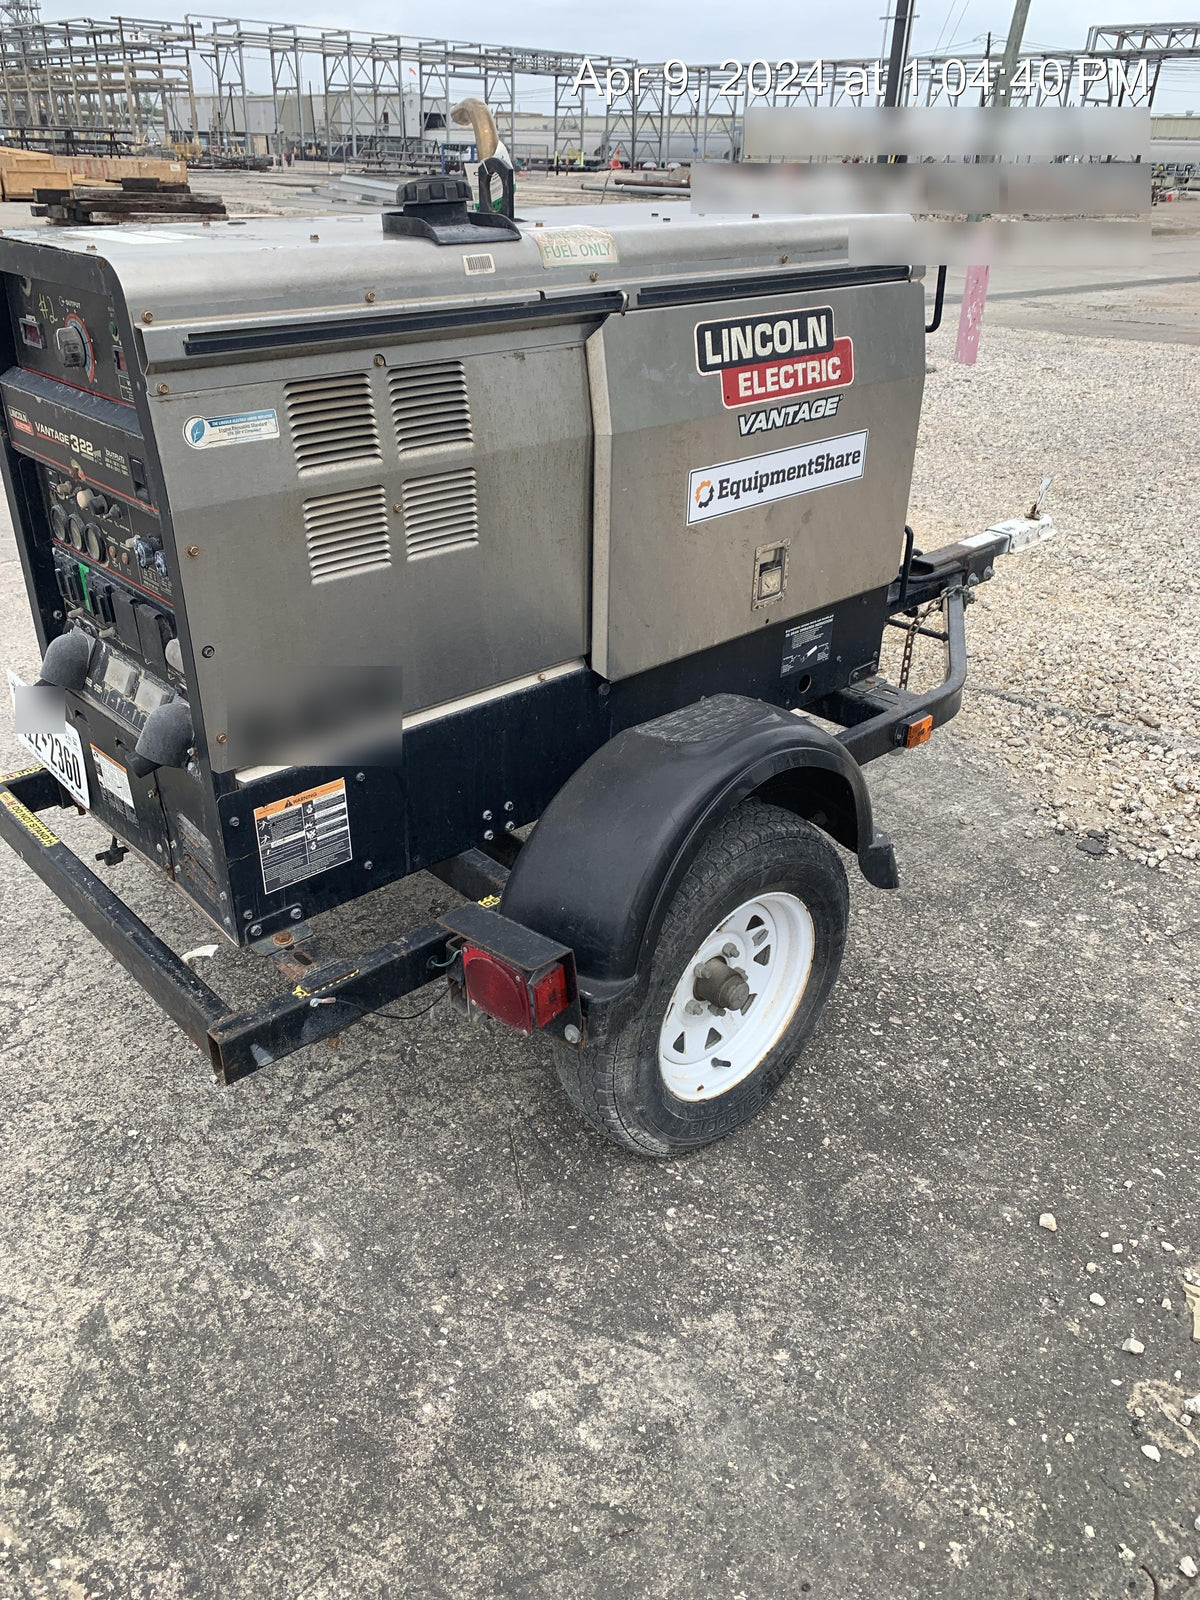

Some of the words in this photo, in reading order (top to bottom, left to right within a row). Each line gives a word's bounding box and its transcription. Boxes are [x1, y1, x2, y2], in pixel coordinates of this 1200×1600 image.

[543, 244, 577, 259] FUEL
[579, 242, 610, 257] ONLY
[704, 314, 828, 365] LINCOLN
[738, 356, 842, 398] ELECTRIC
[738, 396, 841, 437] VANTAGE
[35, 421, 69, 445] VANTAGE
[70, 433, 94, 457] 322
[717, 449, 861, 500] EquipmentShare
[292, 792, 318, 804] WARNING
[12, 805, 22, 814] DO
[21, 813, 32, 824] NOT
[29, 822, 49, 840] STAND
